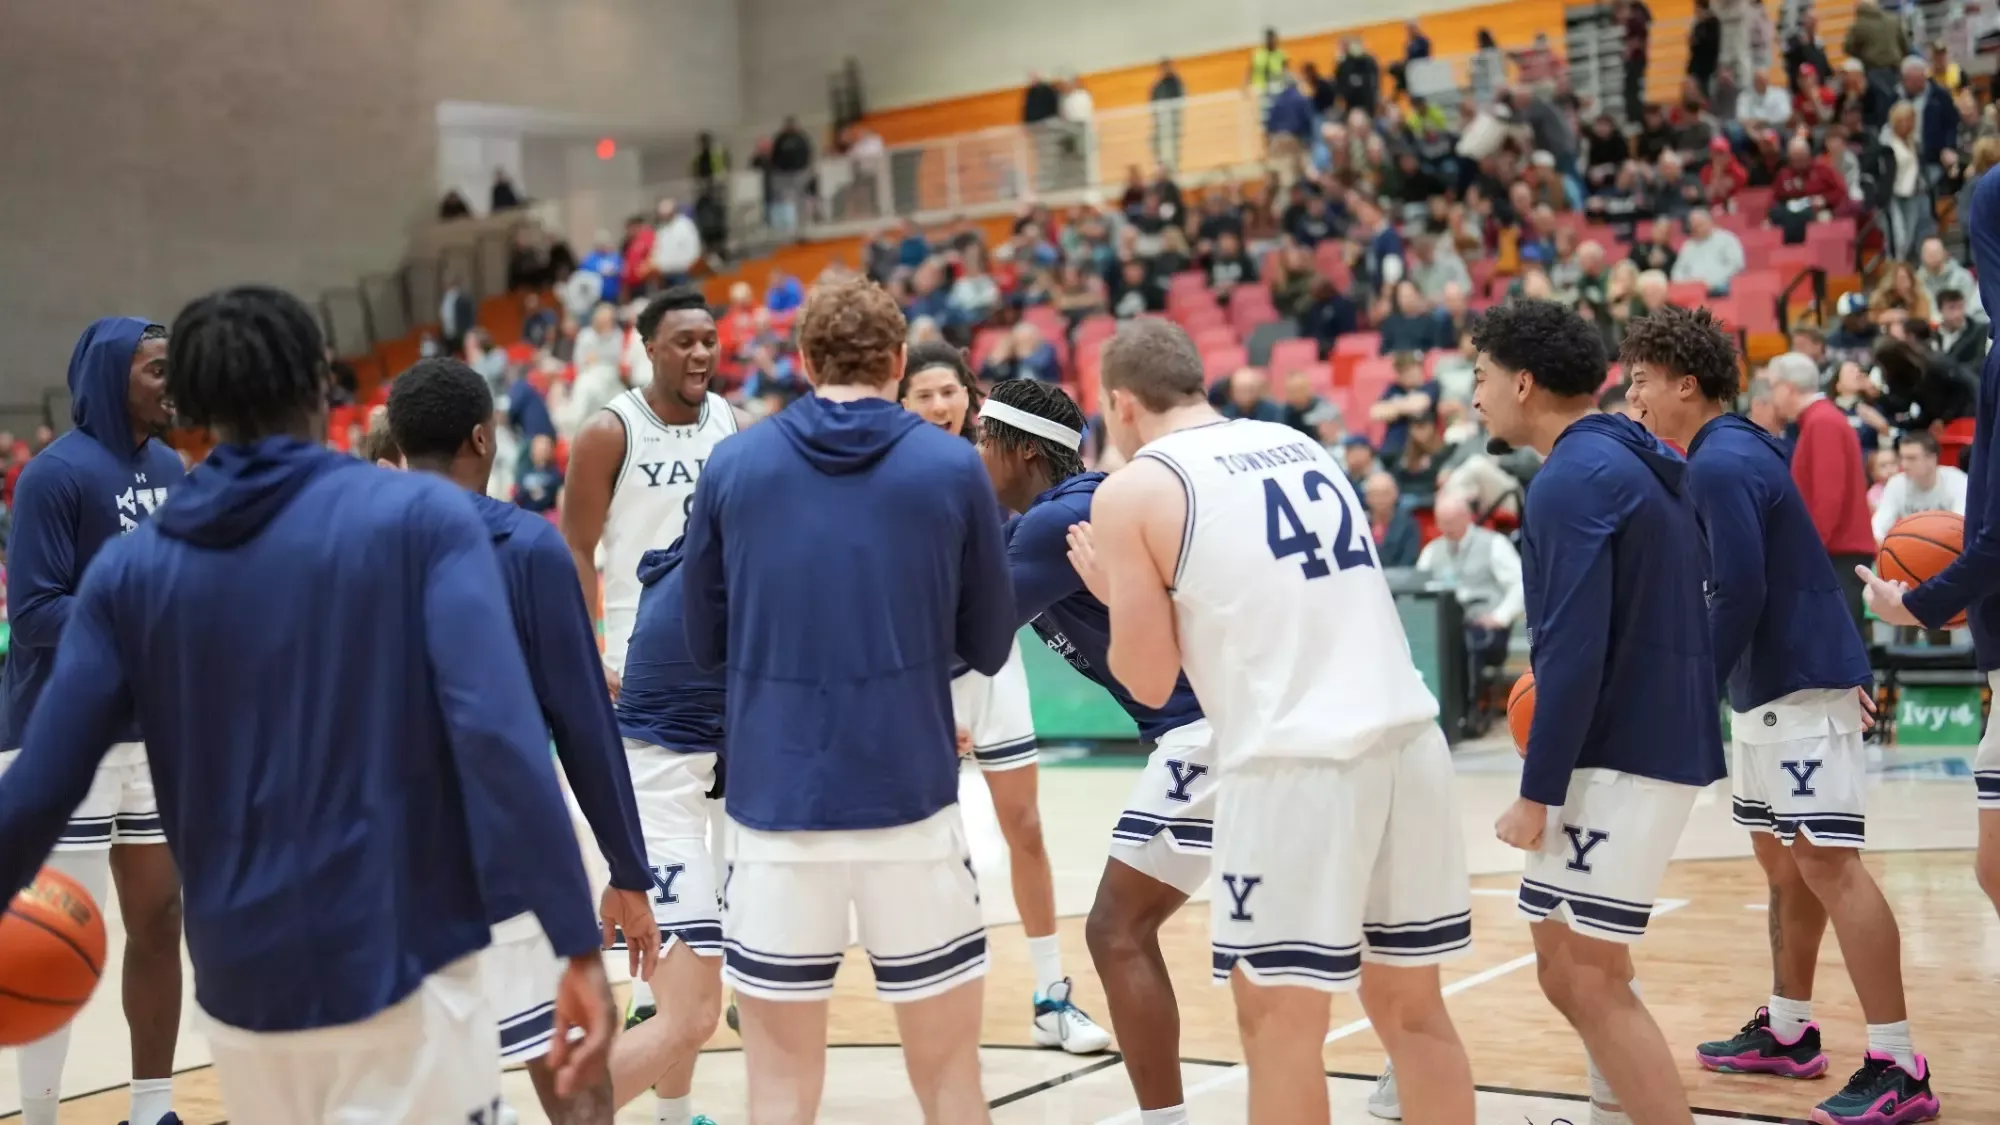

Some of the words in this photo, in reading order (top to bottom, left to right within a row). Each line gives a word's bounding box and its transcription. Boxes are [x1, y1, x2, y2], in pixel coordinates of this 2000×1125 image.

[1262, 470, 1375, 580] 42
[1901, 701, 1949, 732] Ivy
[1165, 759, 1208, 802] Y
[1780, 760, 1823, 797] Y
[1562, 823, 1609, 874] Y
[649, 863, 685, 906] Y
[1223, 873, 1262, 921] Y
